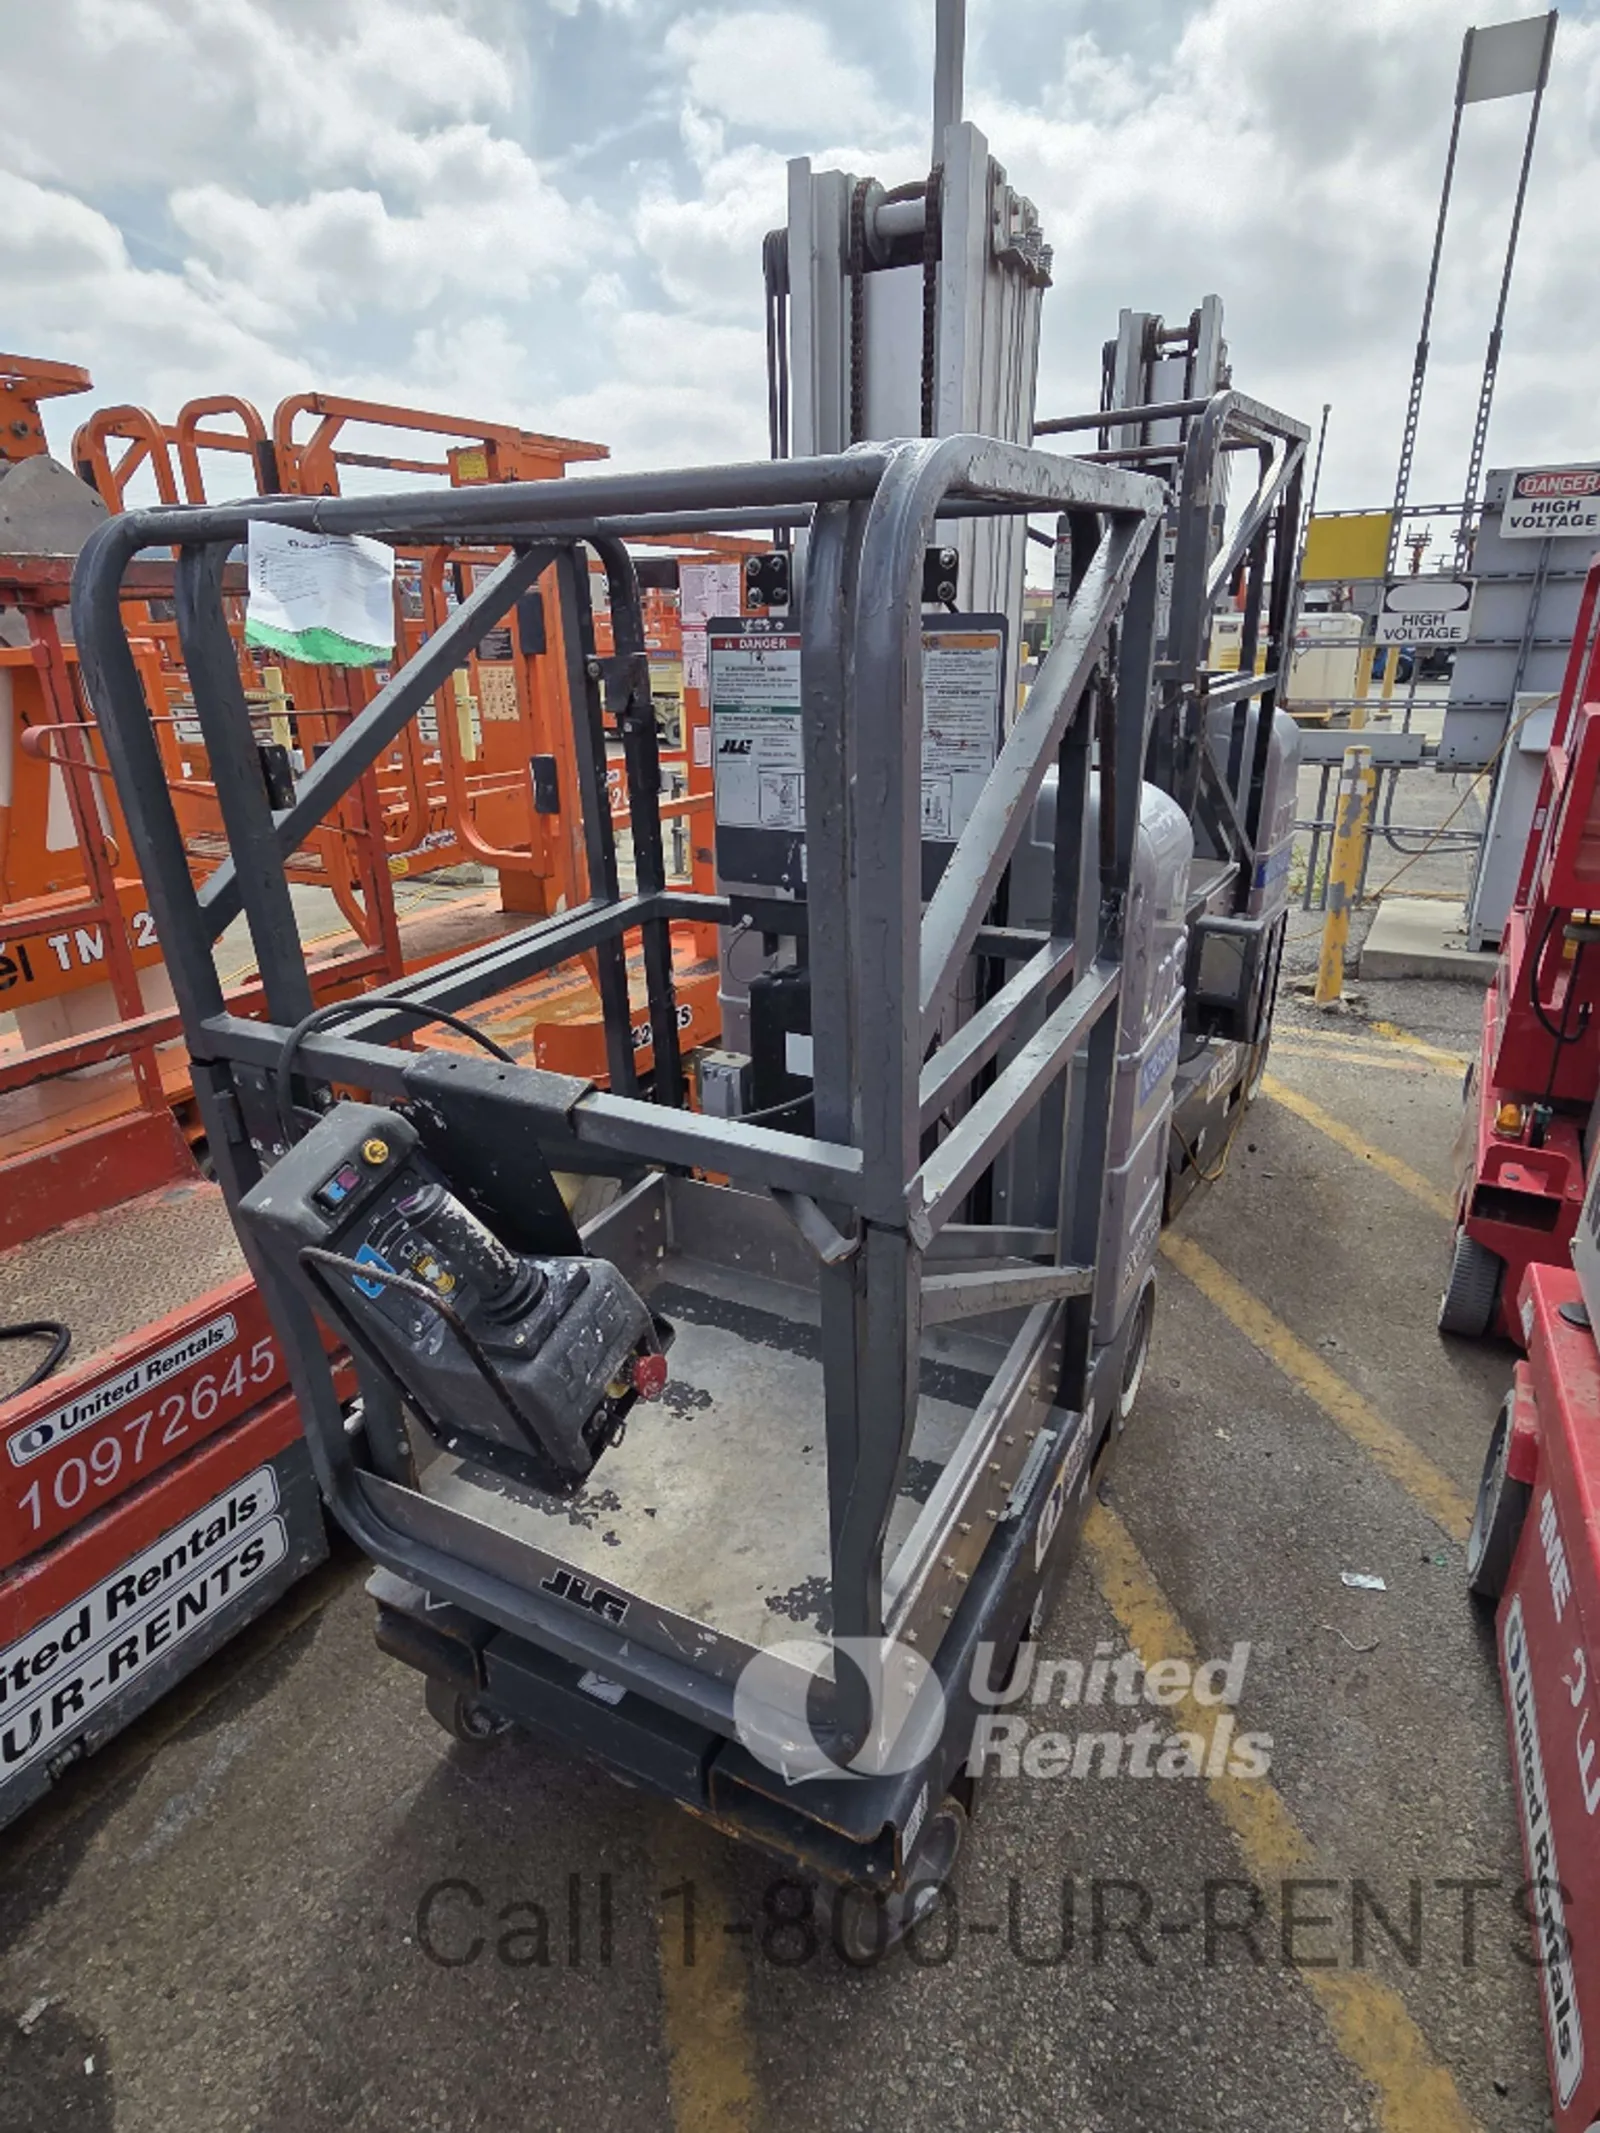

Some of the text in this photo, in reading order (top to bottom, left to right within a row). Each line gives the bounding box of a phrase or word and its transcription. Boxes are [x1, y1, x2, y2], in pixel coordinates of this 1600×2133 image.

[1523, 472, 1599, 493] DANGER
[1509, 514, 1598, 529] VOLTAGE
[1530, 500, 1581, 513] HIGH
[1383, 626, 1463, 640] VOLTAGE
[1401, 613, 1446, 627] HIGH
[739, 637, 787, 650] DANGER
[60, 1326, 225, 1431] United Rentals
[18, 1335, 275, 1530] 10972645
[106, 1493, 257, 1622] Rentals
[540, 1568, 630, 1628] JLG
[2, 1536, 265, 1763] UR-RENTS
[1515, 1671, 1572, 2061] United Rentals
